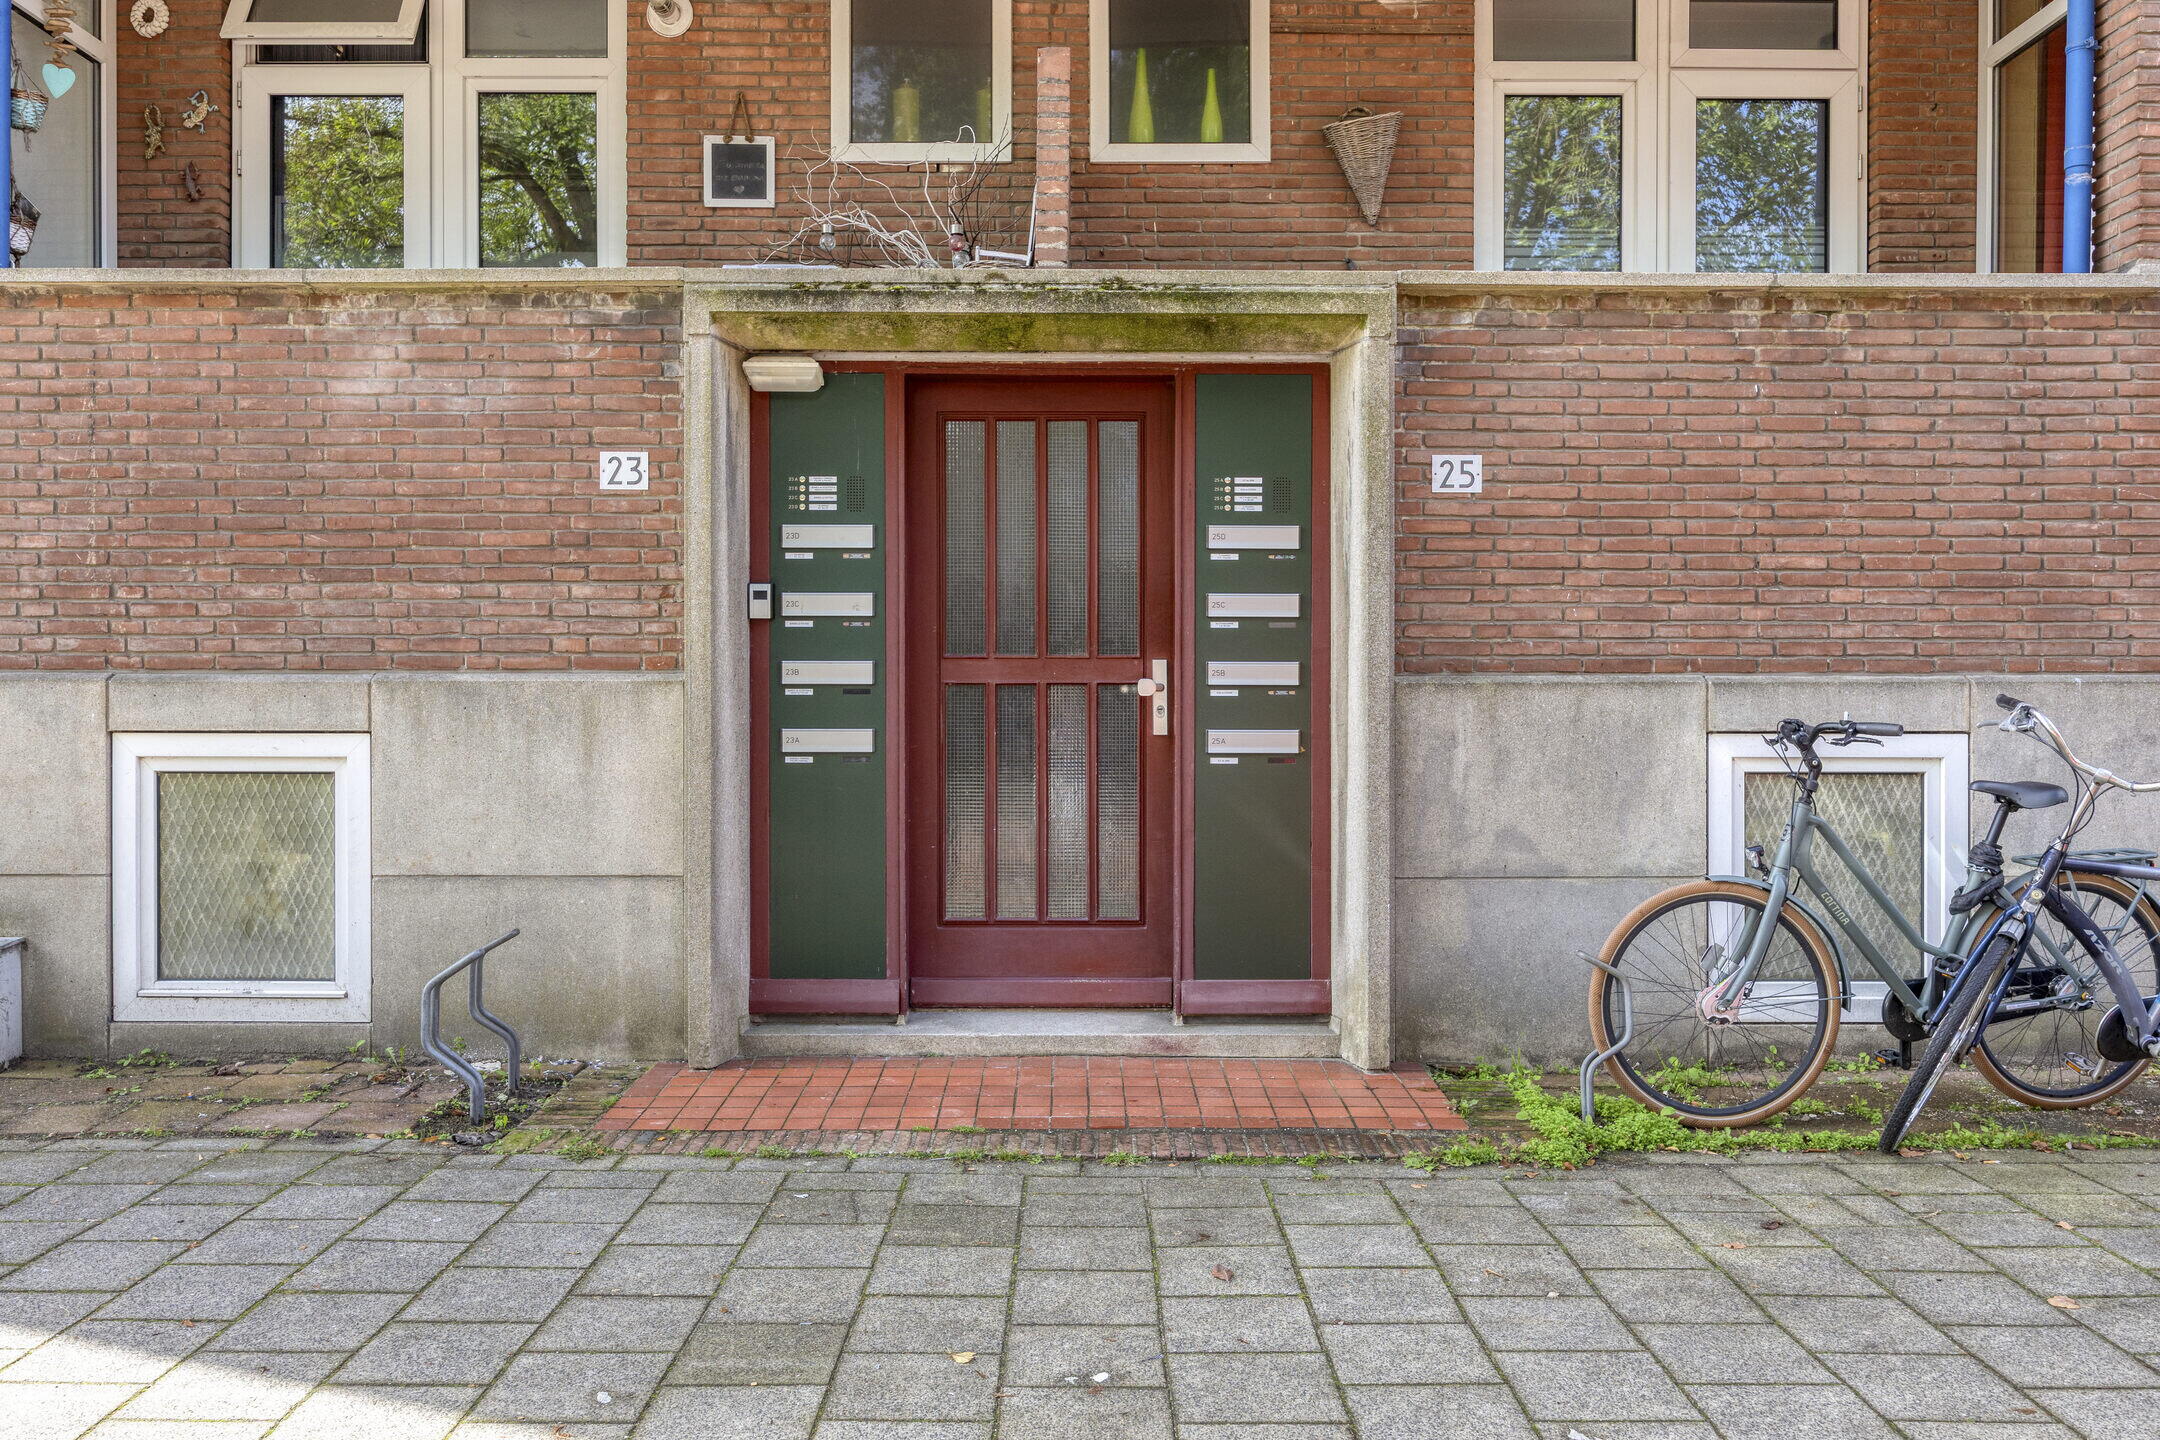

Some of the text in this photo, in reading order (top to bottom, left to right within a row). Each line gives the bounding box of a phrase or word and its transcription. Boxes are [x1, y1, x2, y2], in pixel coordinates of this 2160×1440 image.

[607, 456, 643, 485] 23
[1439, 460, 1475, 488] 25
[1820, 891, 1850, 926] CORTINA
[2083, 928, 2123, 976] AZOR
